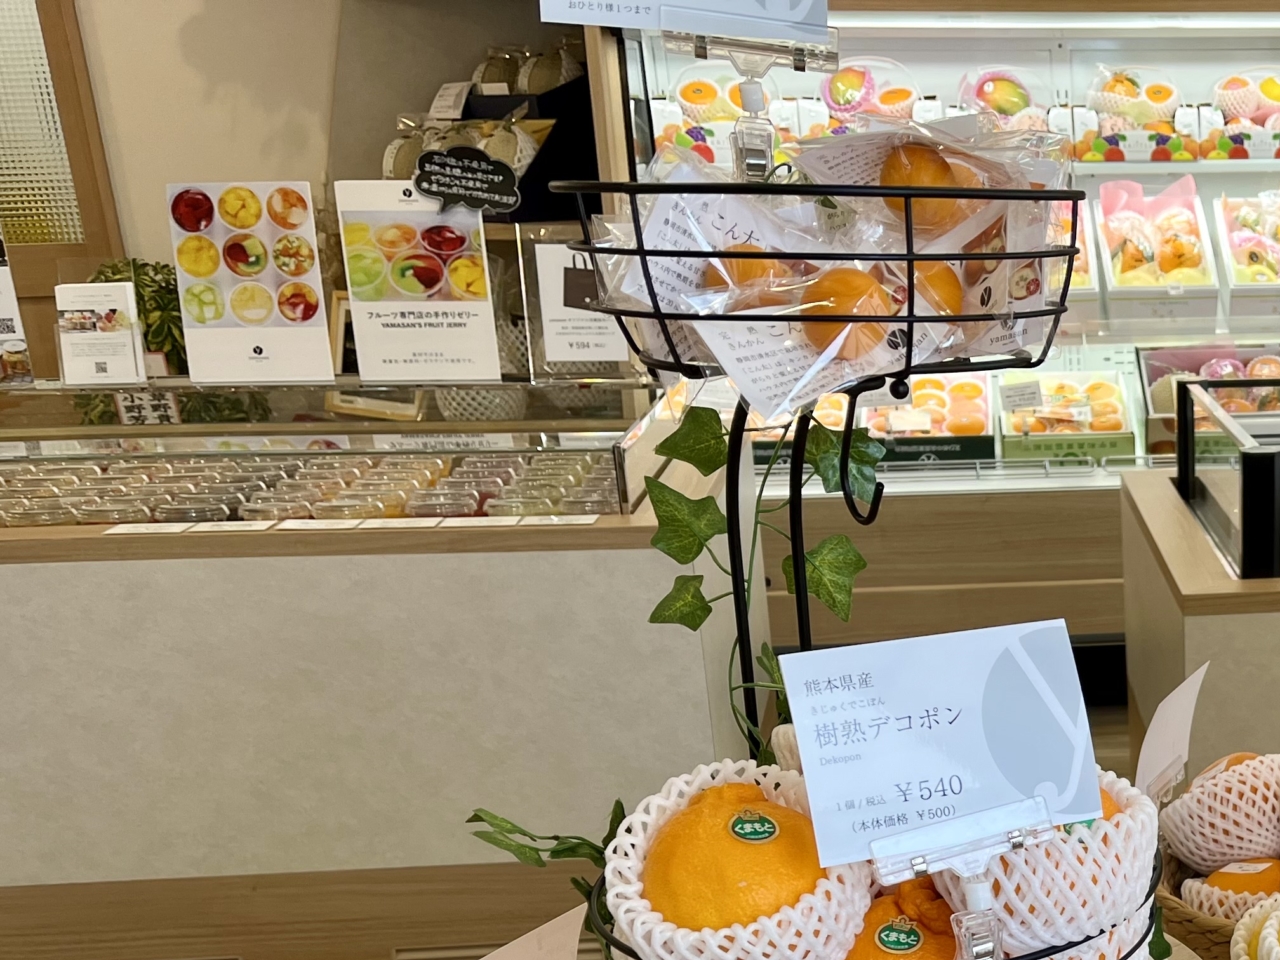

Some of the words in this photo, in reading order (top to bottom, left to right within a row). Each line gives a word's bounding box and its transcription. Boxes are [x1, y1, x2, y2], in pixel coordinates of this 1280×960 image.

[989, 327, 1028, 345] yamasan
[804, 671, 874, 697] 熊本県産
[814, 706, 962, 749] 樹熟デコポン
[819, 752, 862, 767] Dekopon
[894, 773, 963, 803] ¥540
[734, 822, 775, 833] くまもと
[880, 930, 918, 945] くまもと
